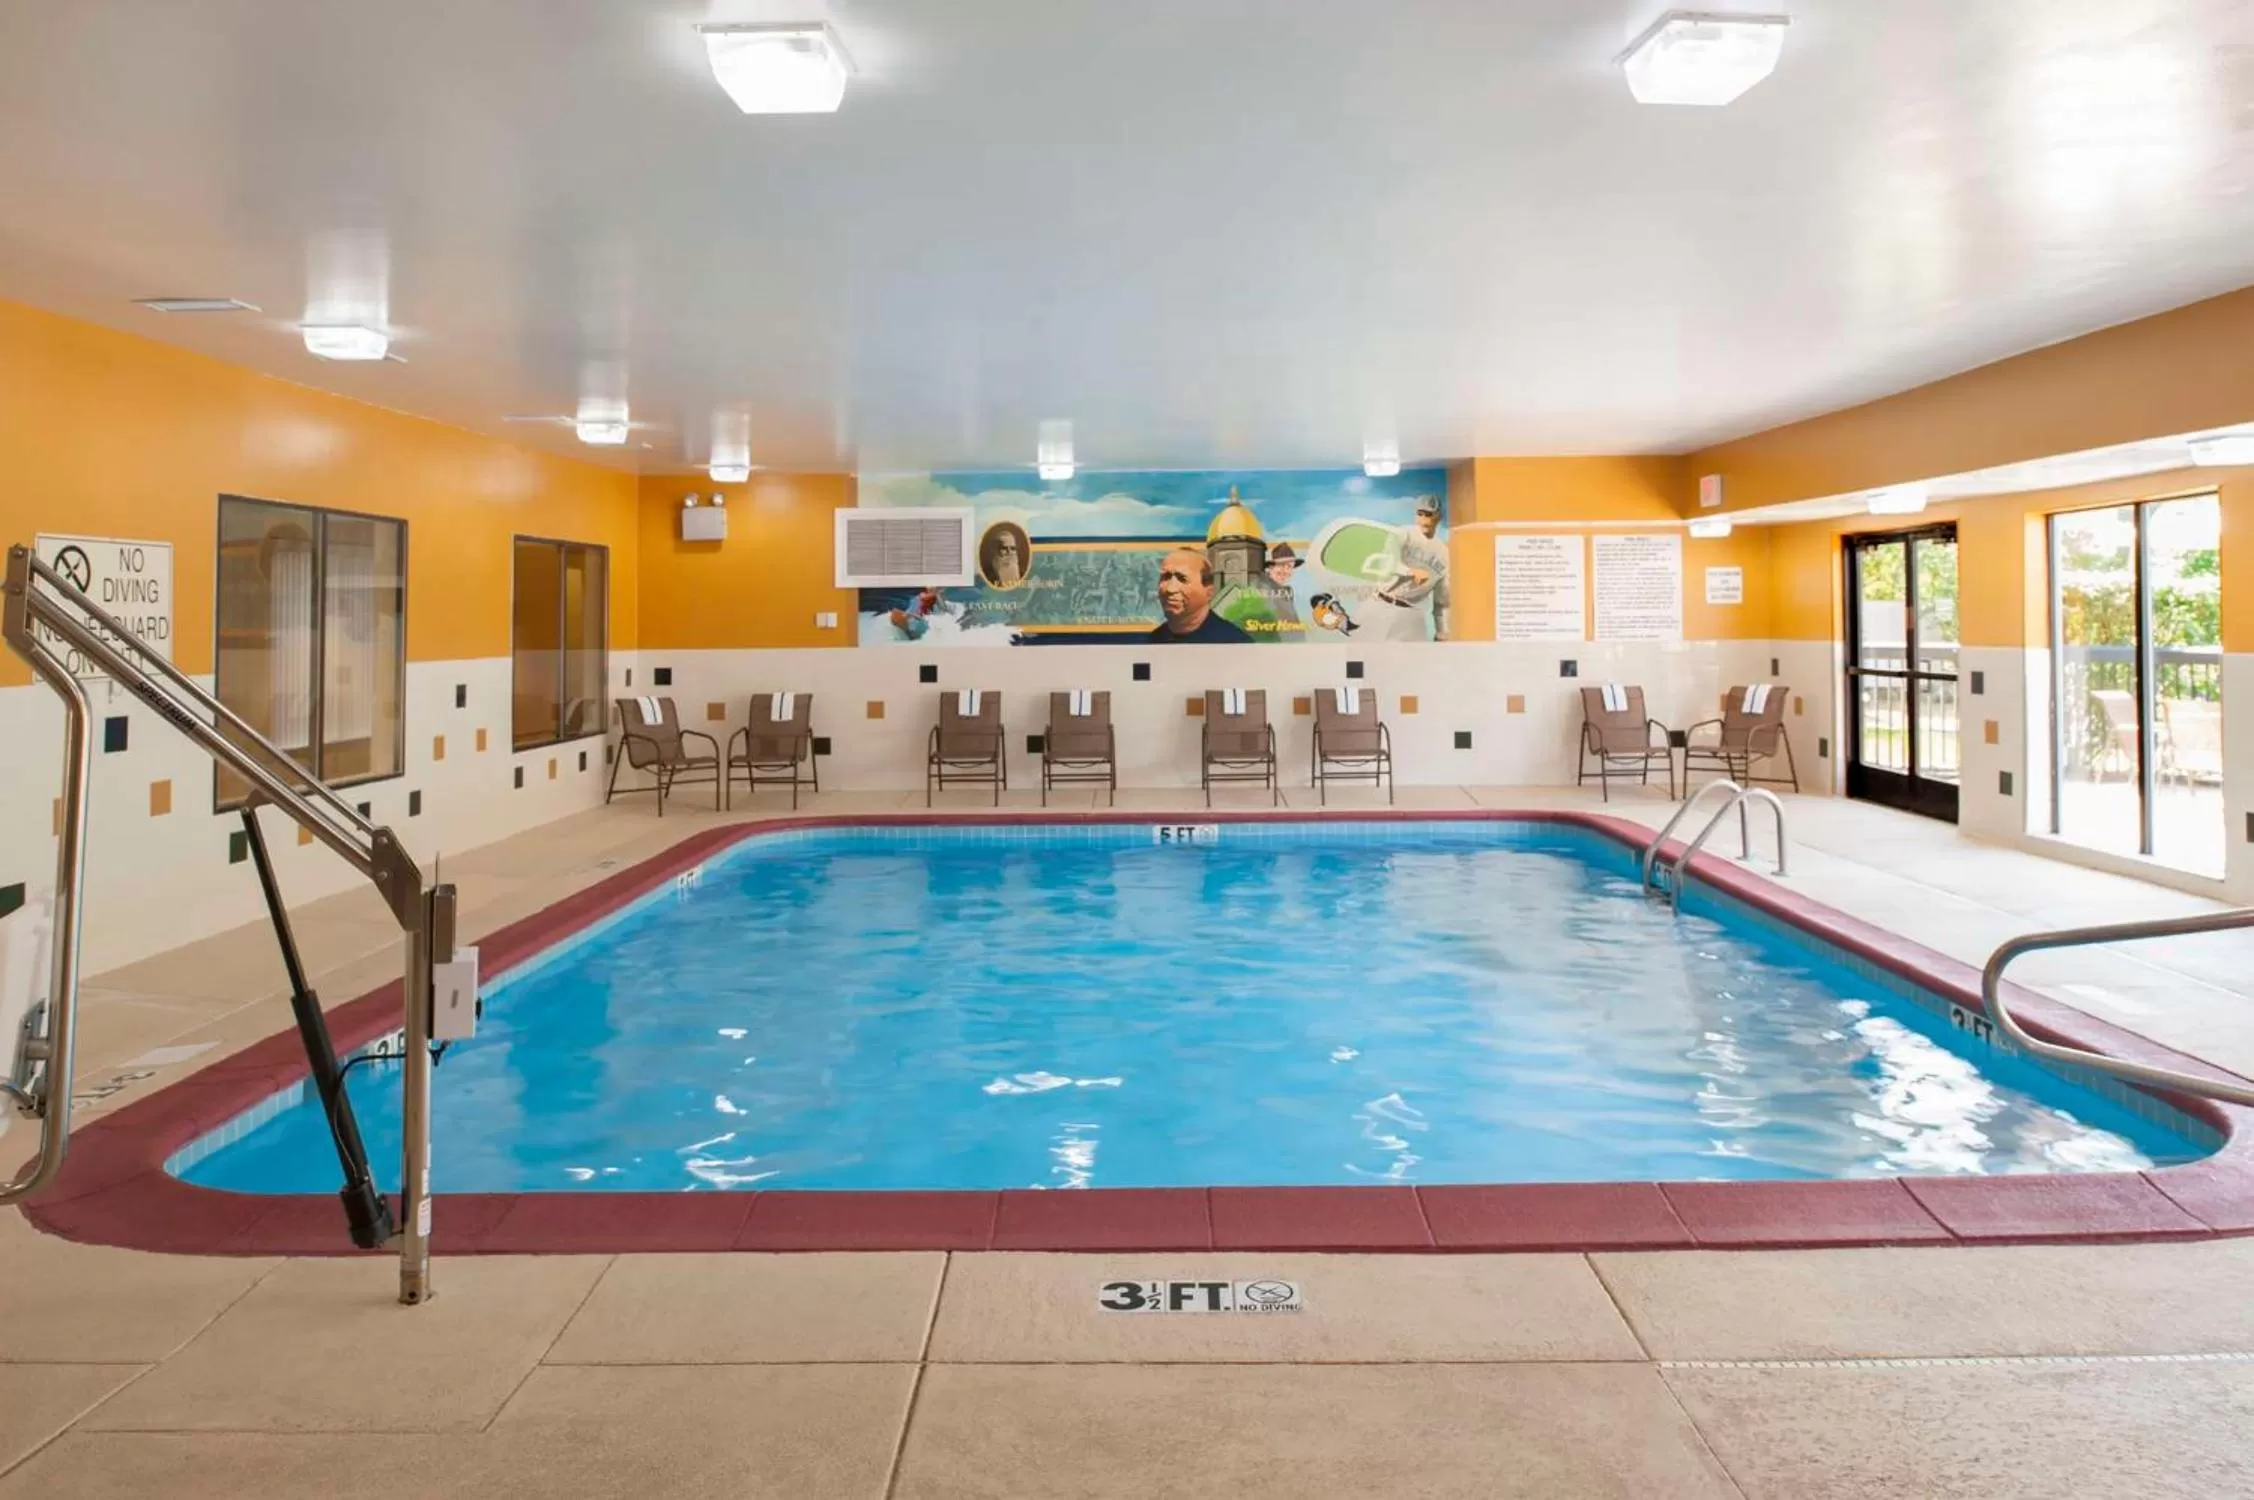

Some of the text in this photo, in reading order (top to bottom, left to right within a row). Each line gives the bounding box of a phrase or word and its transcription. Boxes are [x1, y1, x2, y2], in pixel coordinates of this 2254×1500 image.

[119, 548, 145, 573] NO
[103, 578, 159, 604] DIVING
[83, 615, 169, 642] FEGUARD
[1177, 827, 1195, 842] FT
